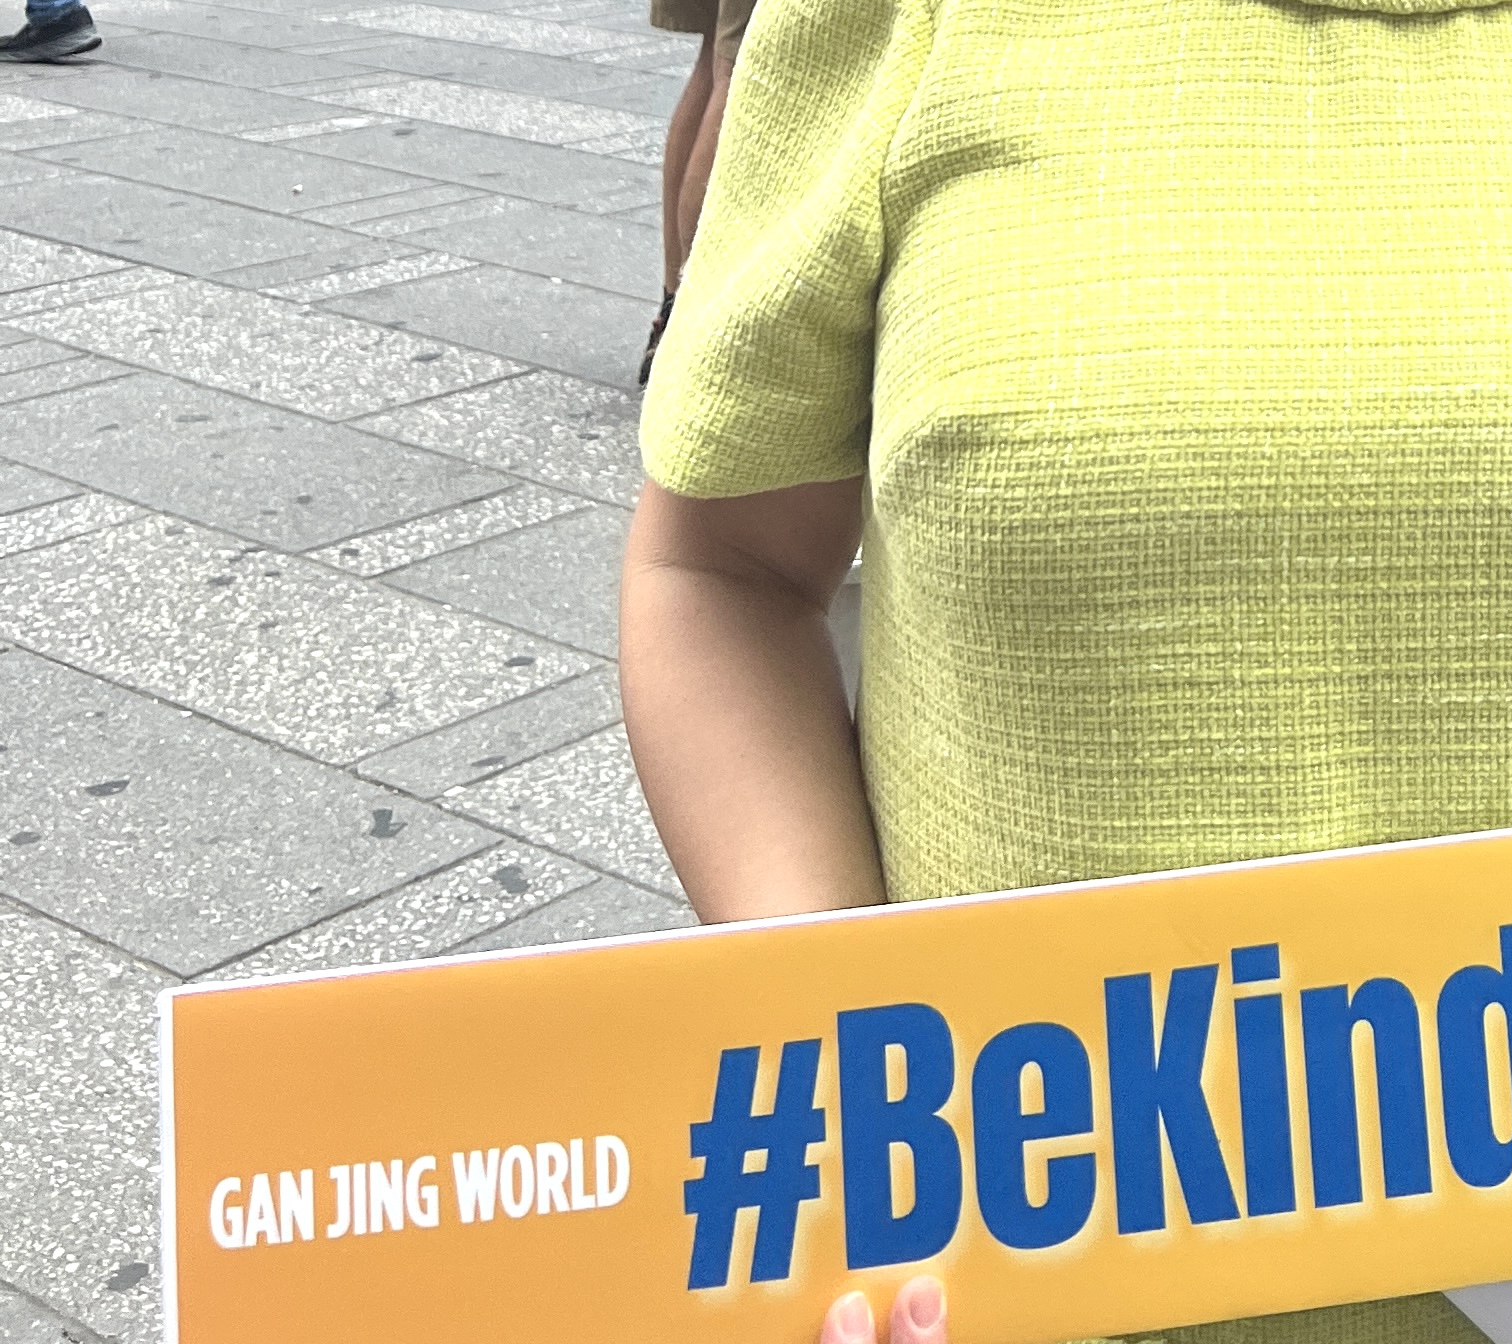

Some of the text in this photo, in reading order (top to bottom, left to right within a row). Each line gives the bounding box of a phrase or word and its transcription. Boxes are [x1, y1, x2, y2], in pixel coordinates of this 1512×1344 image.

[210, 1135, 632, 1249] GAN JING WORLD
